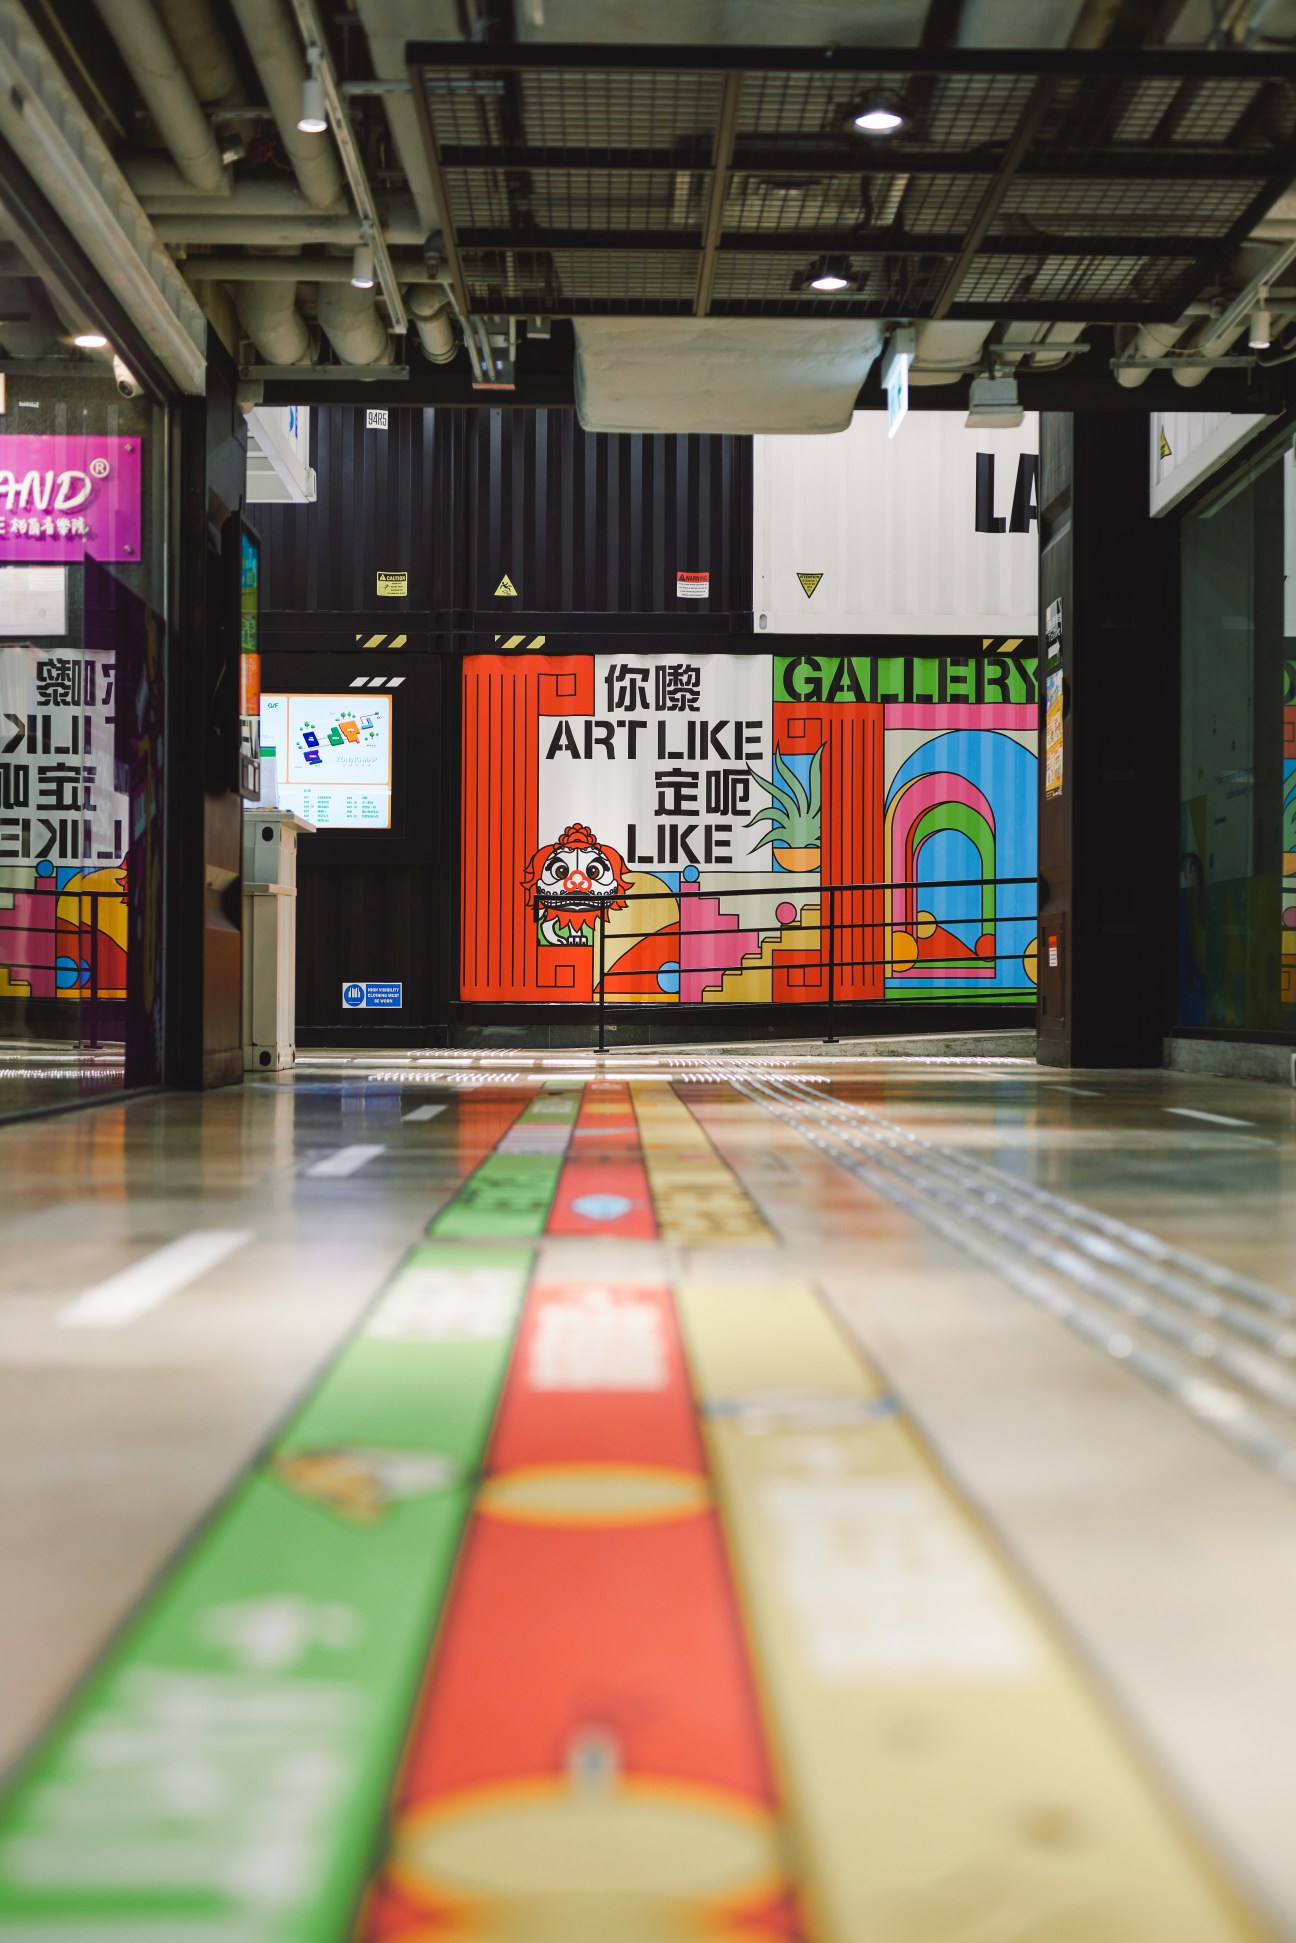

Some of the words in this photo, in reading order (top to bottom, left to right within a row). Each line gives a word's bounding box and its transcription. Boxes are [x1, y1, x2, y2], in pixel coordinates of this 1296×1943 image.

[605, 664, 701, 712] 你嚟
[545, 720, 647, 760] ART
[657, 720, 763, 760] LIKE
[654, 768, 751, 816] 定呃
[627, 824, 733, 864] LIKE
